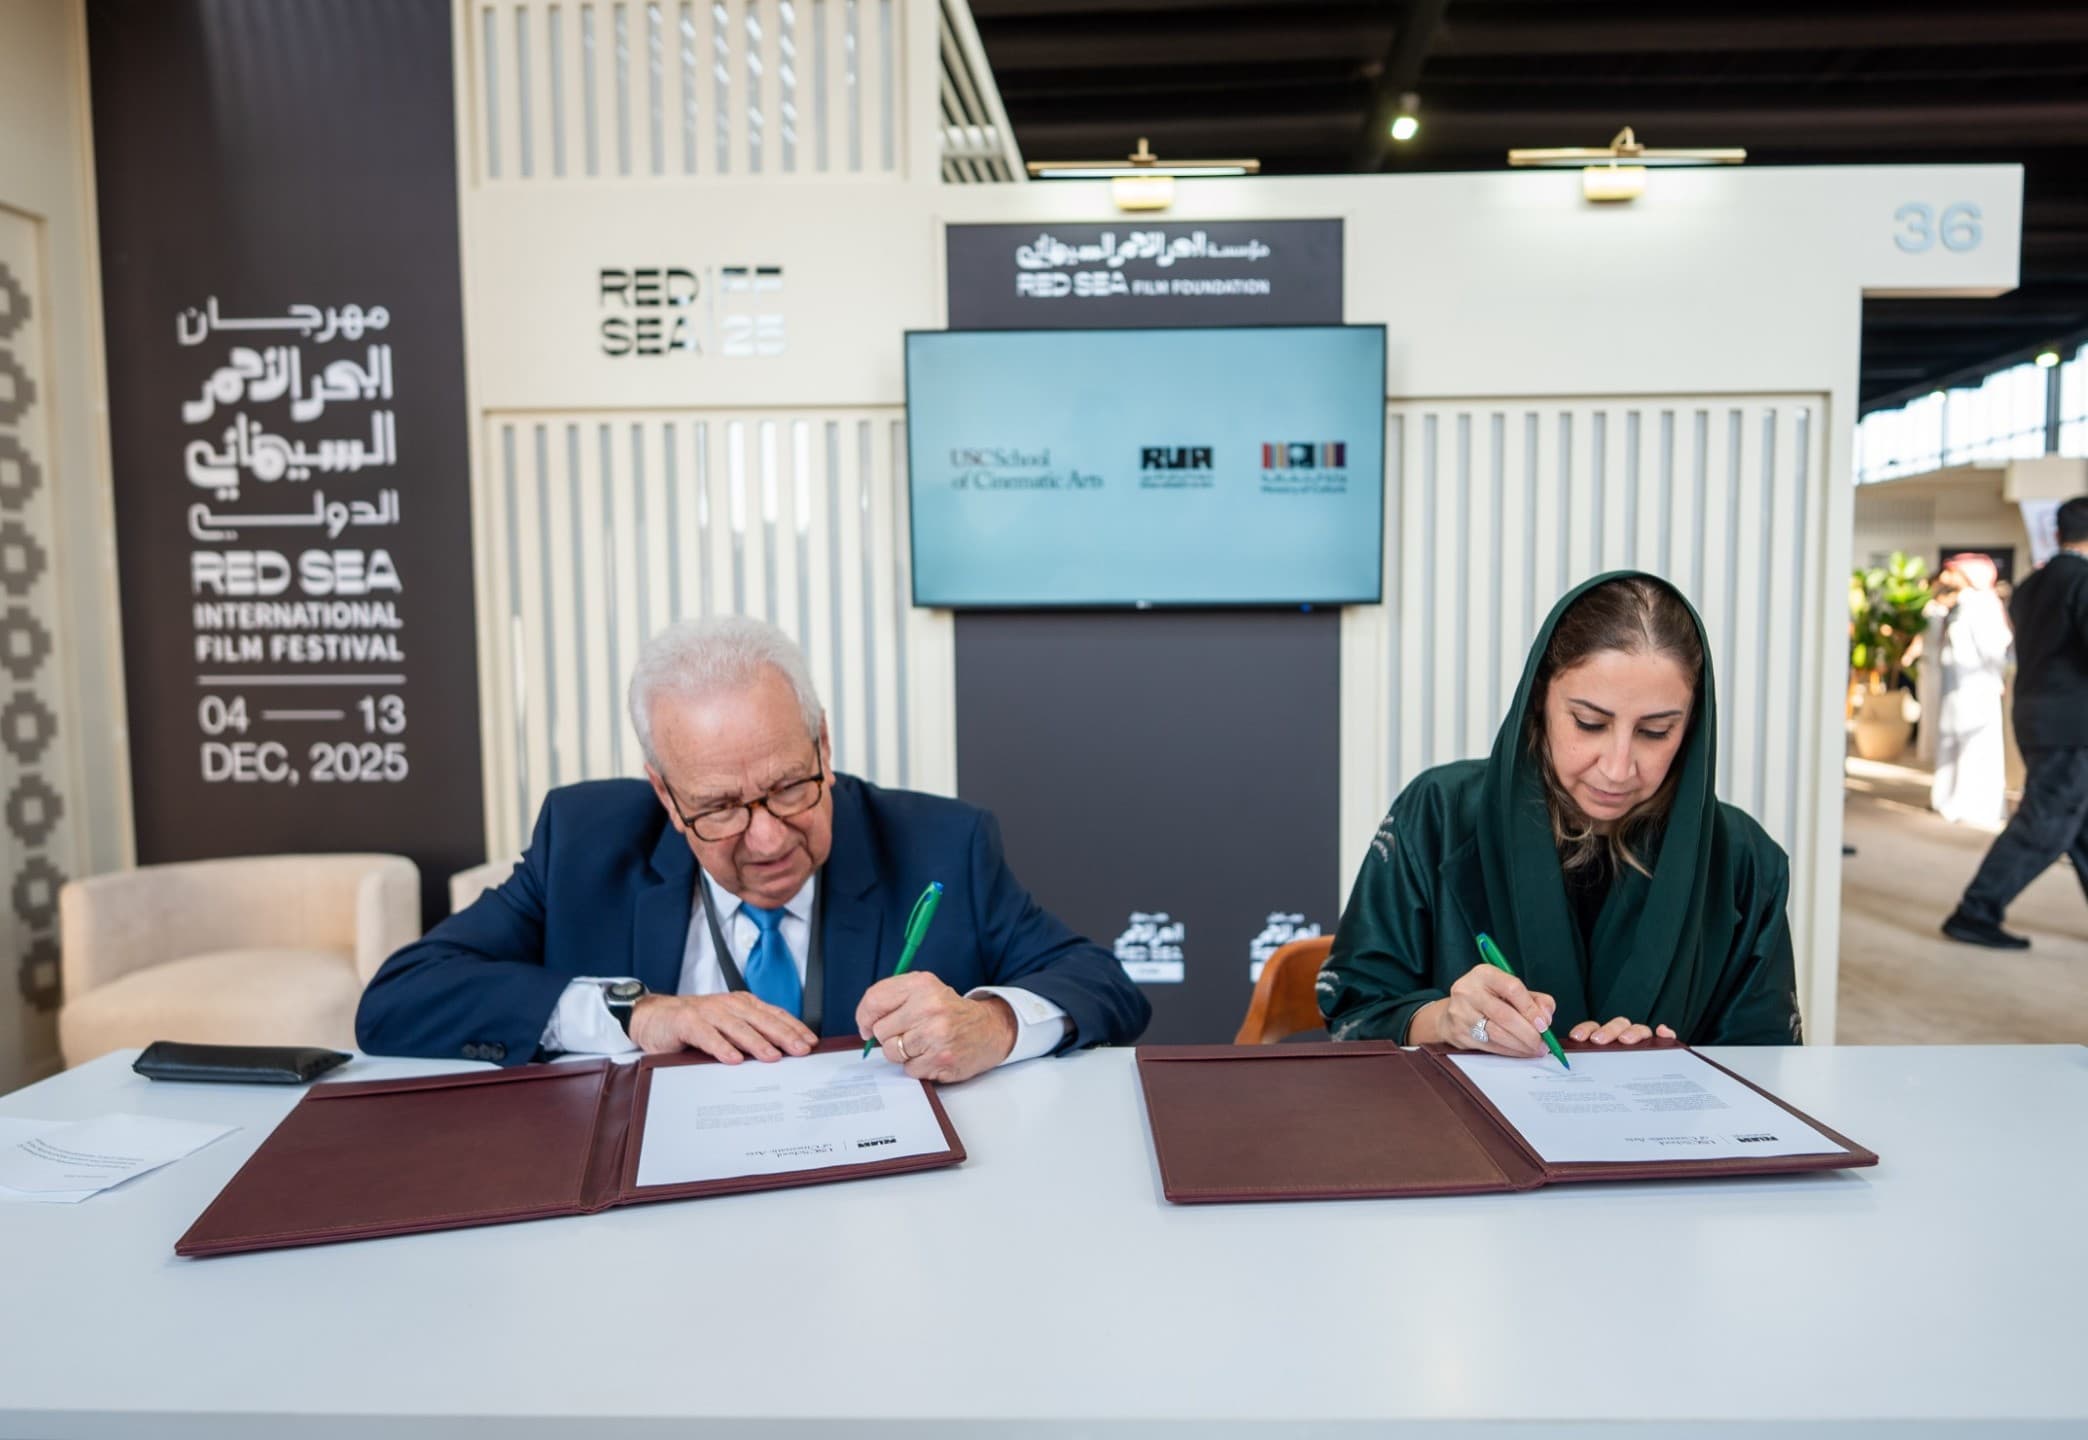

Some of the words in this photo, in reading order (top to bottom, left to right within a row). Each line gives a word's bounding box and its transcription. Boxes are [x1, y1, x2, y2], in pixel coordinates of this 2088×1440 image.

[1893, 201, 1983, 253] 36
[599, 268, 699, 307] RED
[1016, 271, 1072, 297] RED
[1073, 271, 1130, 297] SEA
[1132, 279, 1169, 295] FILM
[1171, 279, 1270, 295] FOUNDATION
[177, 296, 390, 345] مهرجان
[601, 316, 702, 357] SEA
[291, 345, 393, 422] البحر
[989, 447, 1050, 468] School
[952, 470, 970, 489] of
[1067, 470, 1105, 489] Arts
[188, 489, 399, 541] الدولي
[191, 550, 292, 595] RED
[298, 550, 402, 595] SEA
[193, 602, 403, 630] INTERNATIONAL
[195, 634, 263, 662] FILM
[270, 634, 404, 662] FESTIVAL
[199, 695, 249, 735] 04
[357, 694, 406, 734] 13
[201, 741, 299, 787] DEC,
[308, 741, 408, 782] 2025
